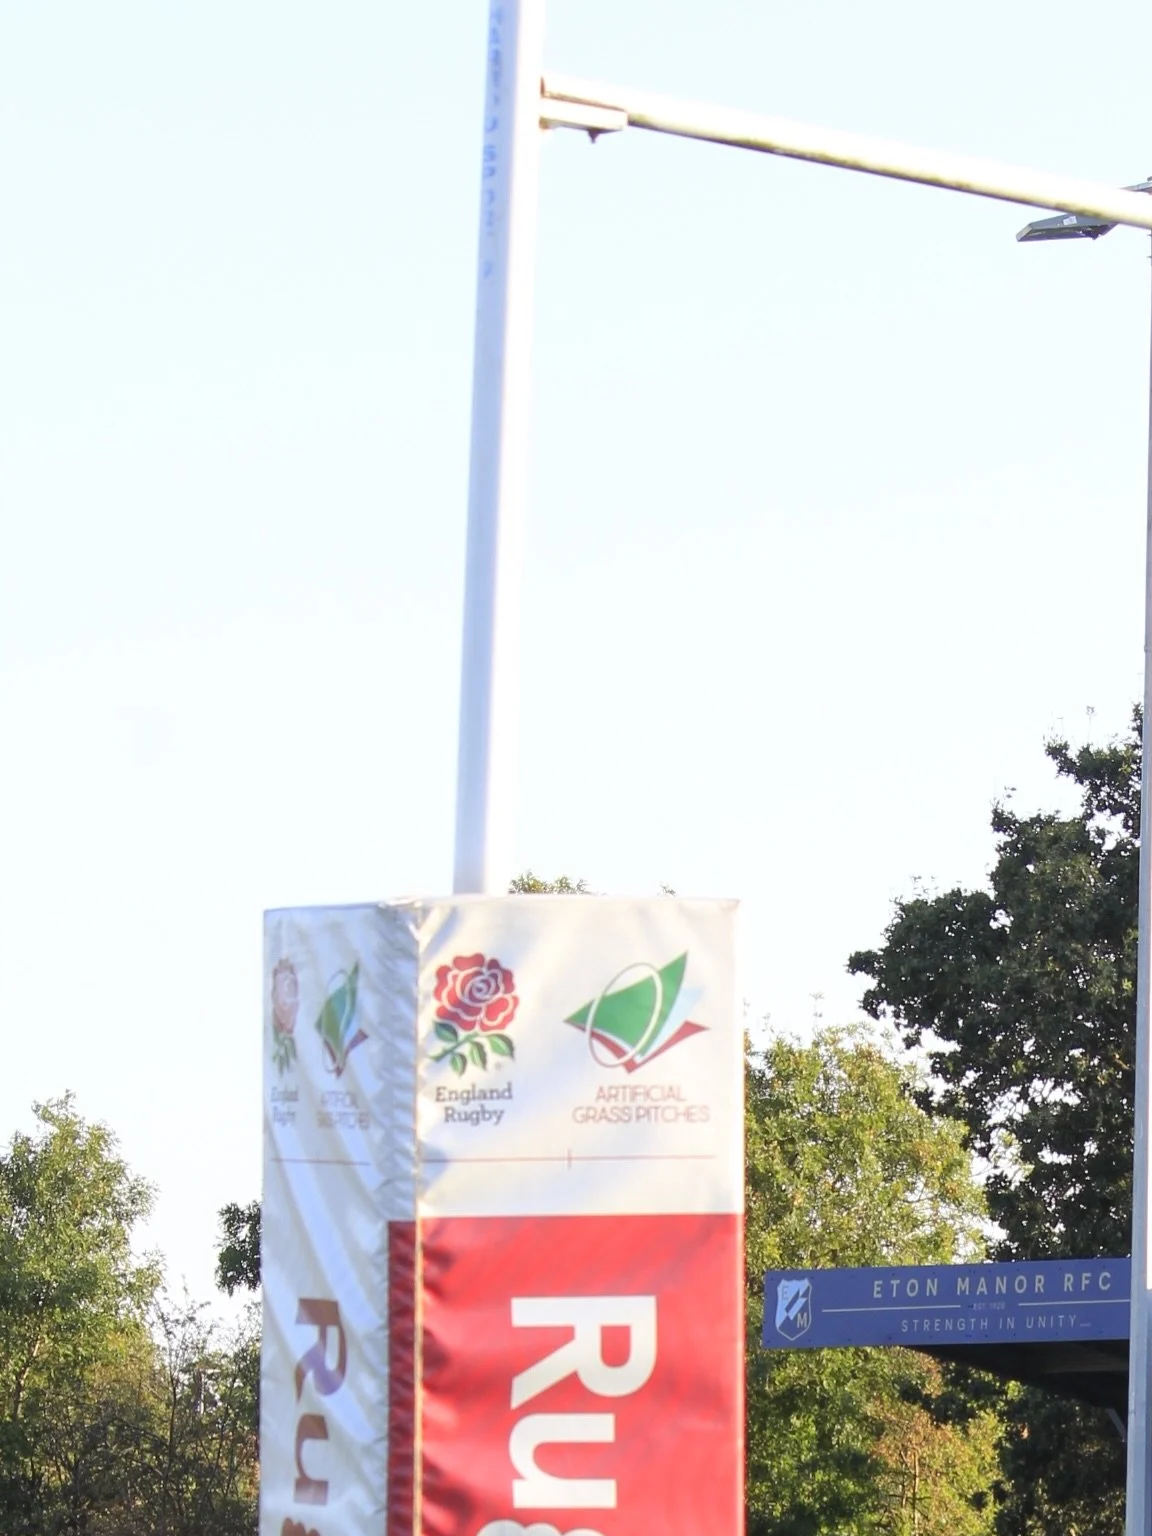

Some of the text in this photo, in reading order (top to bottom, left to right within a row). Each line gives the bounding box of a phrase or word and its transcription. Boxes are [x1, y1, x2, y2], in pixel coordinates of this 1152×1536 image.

[435, 1082, 514, 1107] England
[595, 1084, 687, 1103] ARTIFICIAL
[443, 1105, 505, 1126] Rugby
[572, 1105, 711, 1124] GRASS PITCHES
[873, 1271, 1112, 1298] ETON MANOR RFC
[796, 1312, 808, 1329] M
[901, 1317, 989, 1333] STRENGTH
[999, 1317, 1015, 1330] IN
